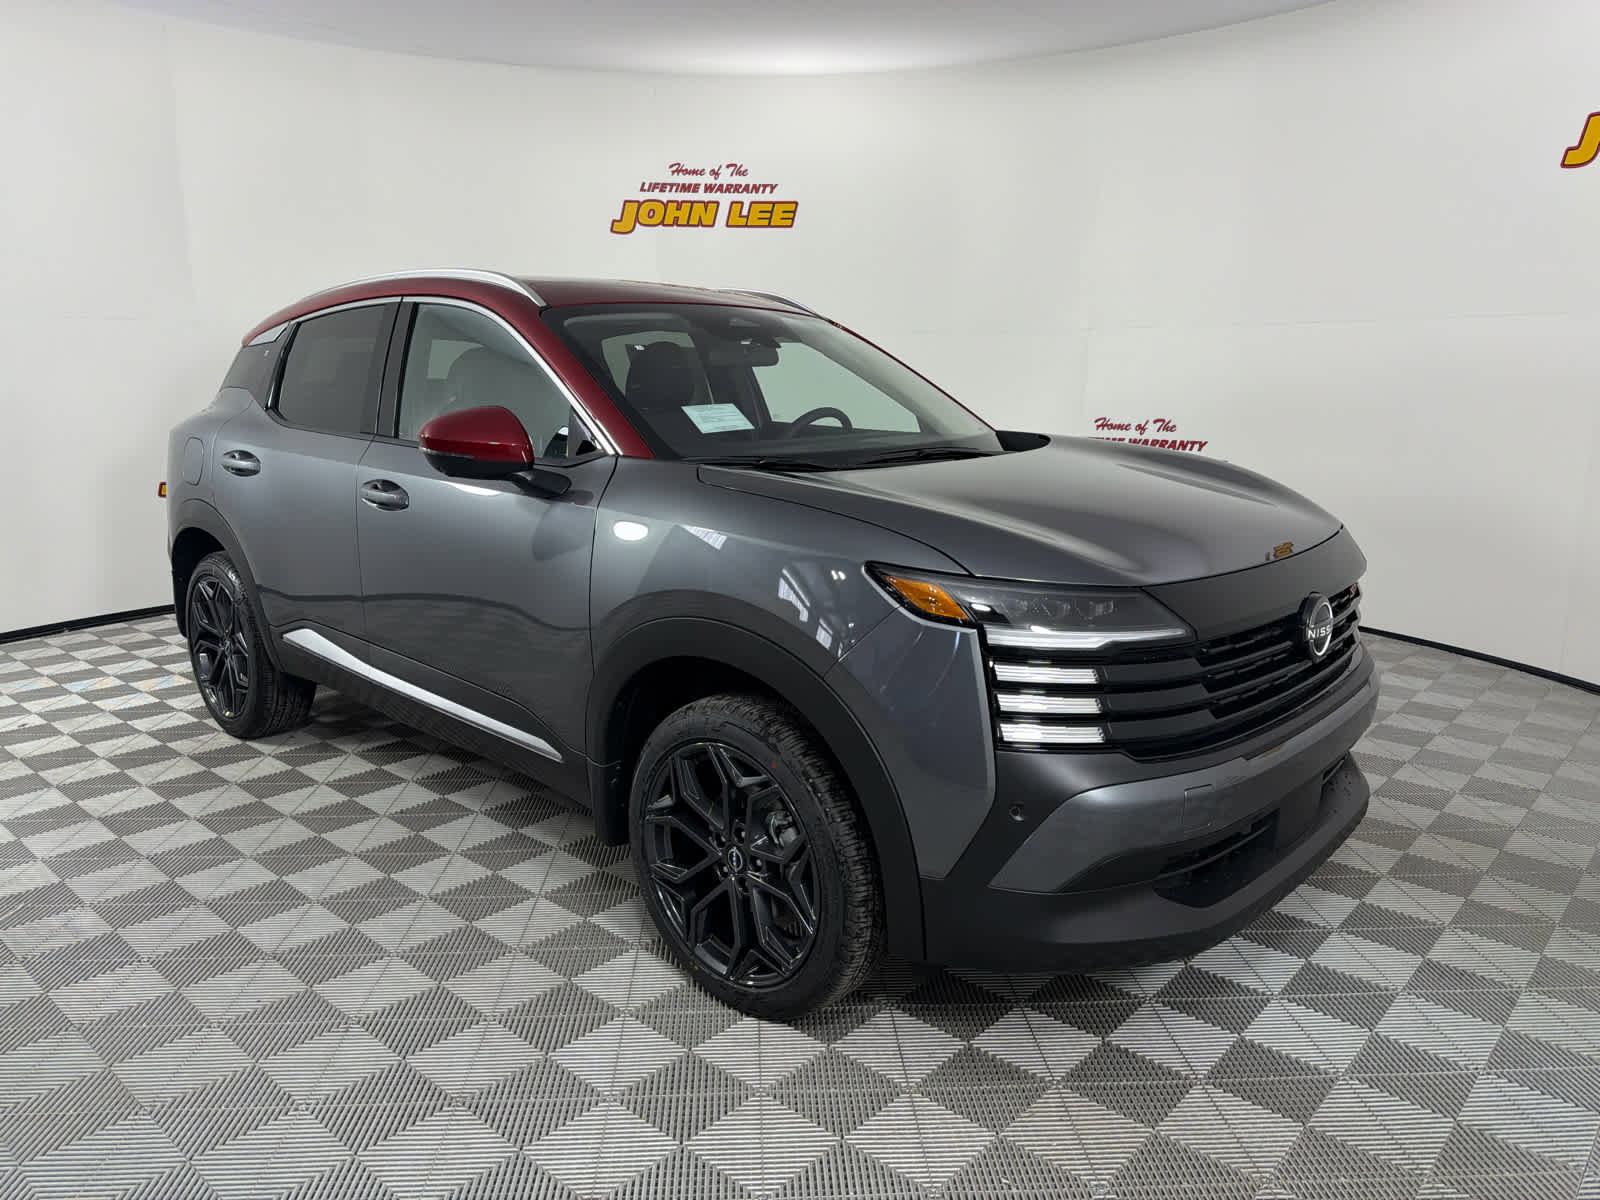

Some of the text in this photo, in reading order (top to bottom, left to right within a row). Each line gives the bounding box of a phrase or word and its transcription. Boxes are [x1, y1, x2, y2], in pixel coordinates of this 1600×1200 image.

[668, 162, 749, 180] Home of The
[639, 182, 778, 194] LIFETIME WARRANTY
[610, 199, 798, 234] JOHN LEE
[1094, 416, 1177, 435] Home of The
